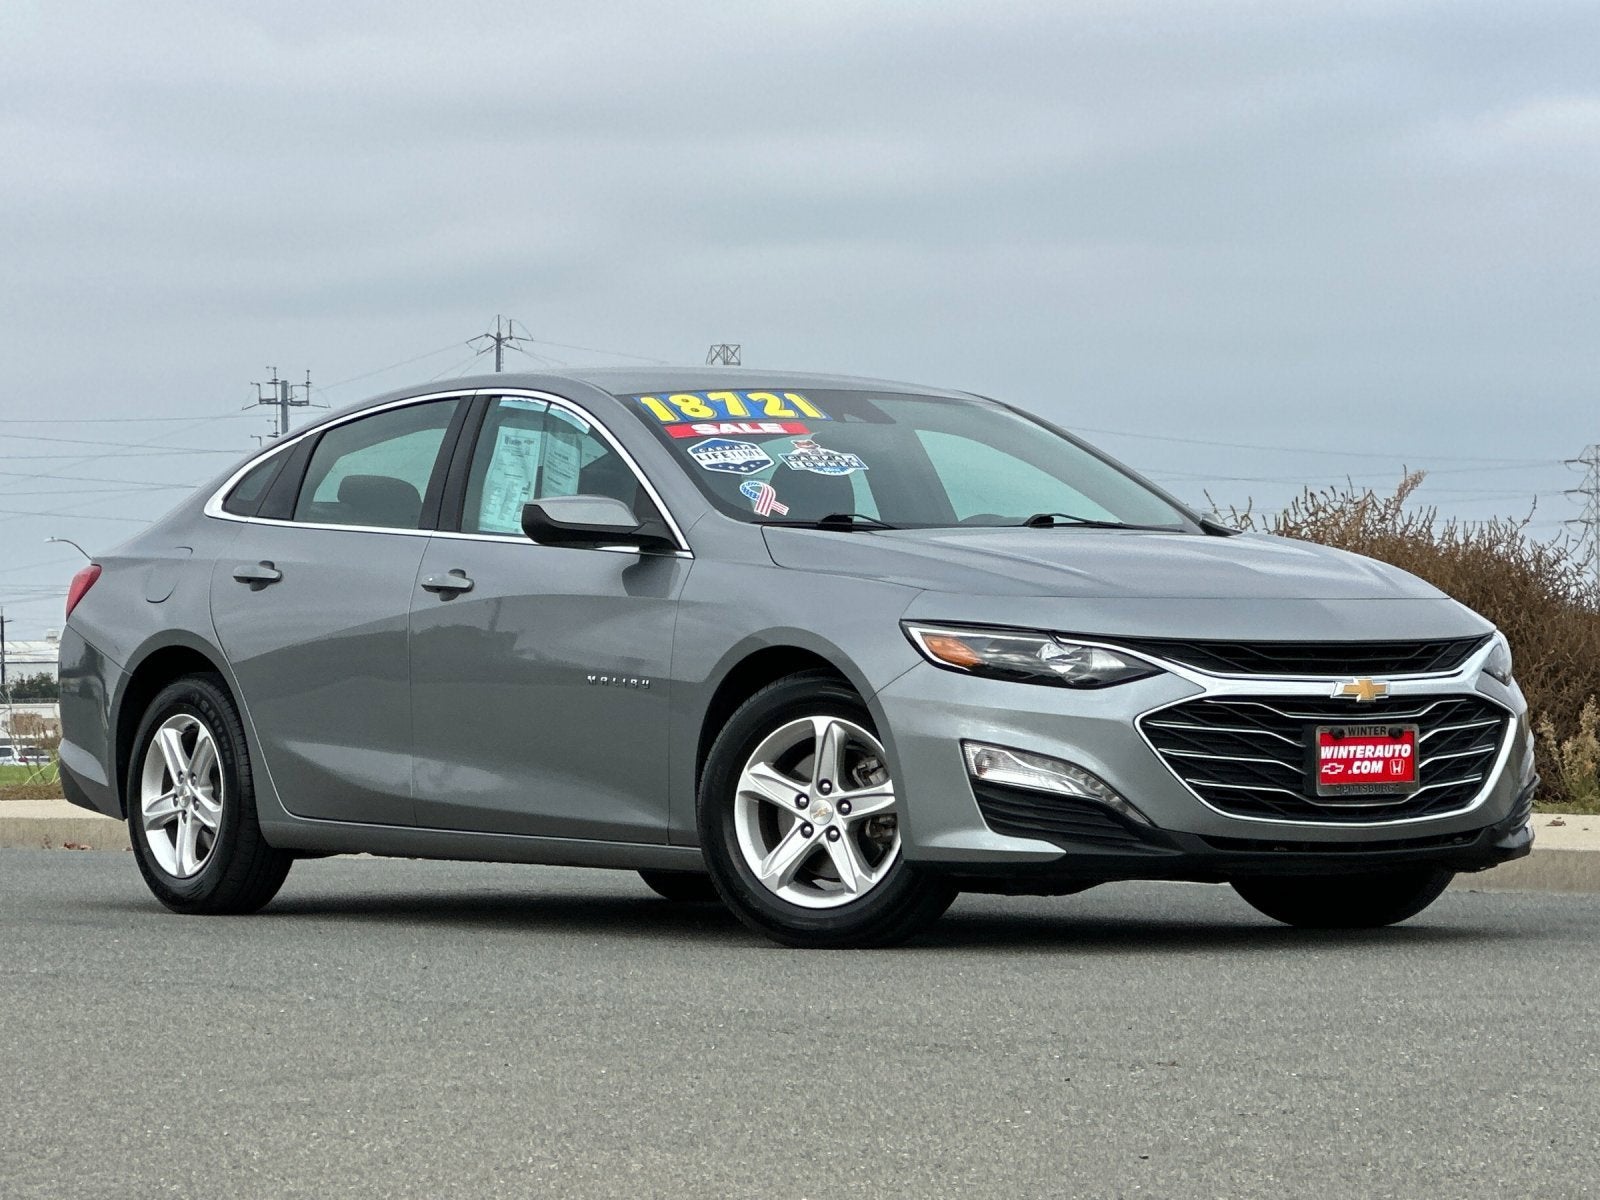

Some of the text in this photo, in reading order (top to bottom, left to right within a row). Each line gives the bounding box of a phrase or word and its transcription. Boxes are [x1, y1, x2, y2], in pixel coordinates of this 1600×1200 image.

[640, 391, 827, 422] 18721
[691, 422, 788, 435] SALE
[696, 450, 763, 461] LIFETIME
[1348, 726, 1387, 736] WINTER
[1320, 743, 1412, 760] WINTERAUTO
[1347, 760, 1384, 775] .COM
